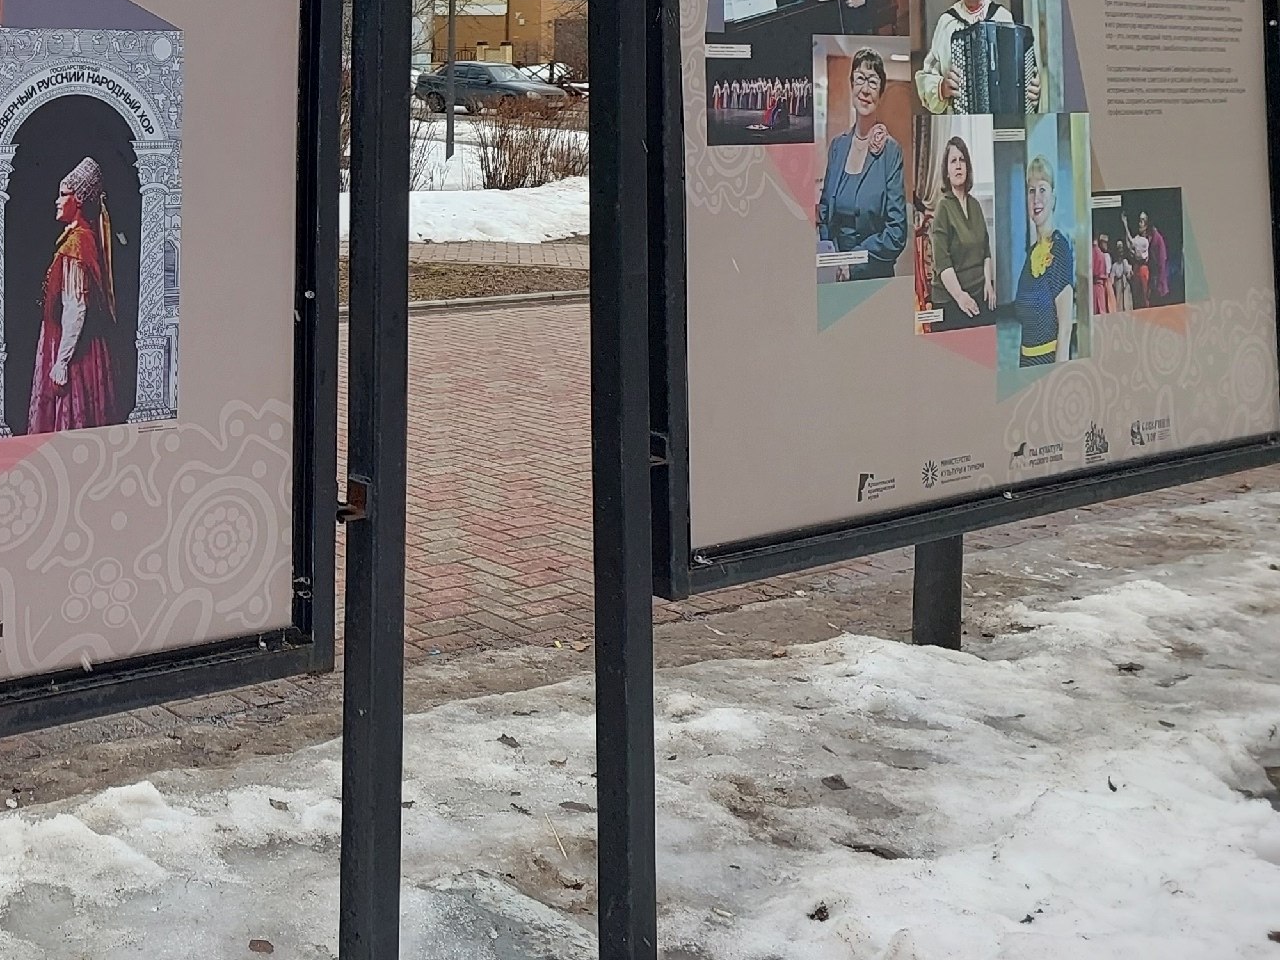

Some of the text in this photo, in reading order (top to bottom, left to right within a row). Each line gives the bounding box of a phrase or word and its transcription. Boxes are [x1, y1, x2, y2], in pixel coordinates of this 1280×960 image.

[36, 71, 85, 92] РУССКИЙ
[87, 71, 141, 114] НАРОДНЫЙ
[138, 111, 154, 135] ХОР
